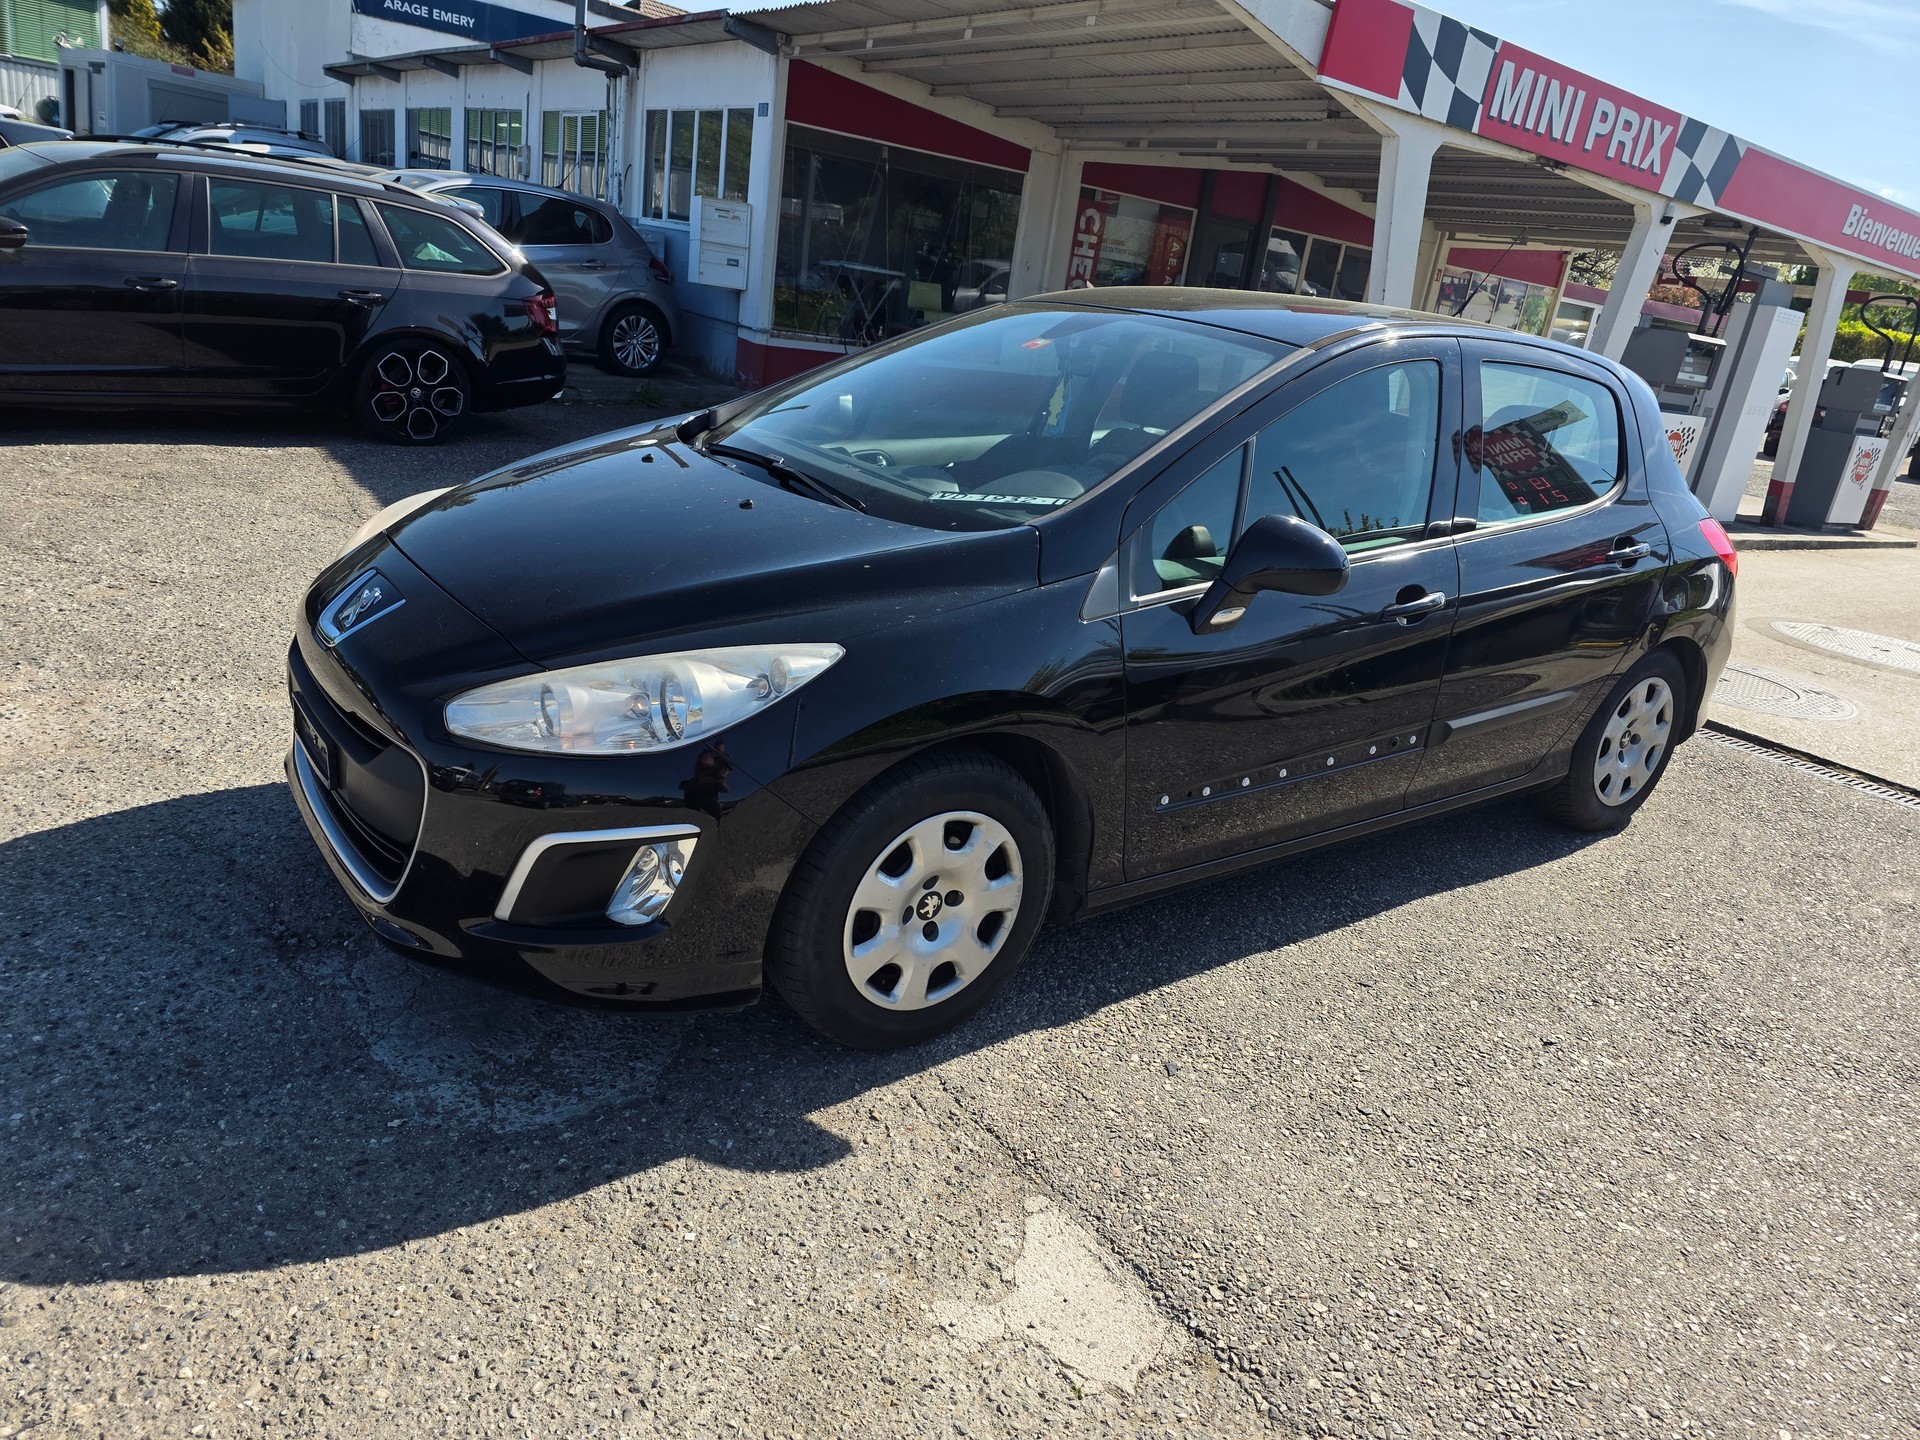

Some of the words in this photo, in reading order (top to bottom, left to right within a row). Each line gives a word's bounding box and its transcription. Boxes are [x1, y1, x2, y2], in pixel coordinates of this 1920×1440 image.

[432, 9, 475, 28] EMERY
[1489, 60, 1587, 144] MINI
[1584, 97, 1674, 175] PRIX
[1842, 203, 1920, 260] Bienvenue
[1835, 369, 1845, 386] 1
